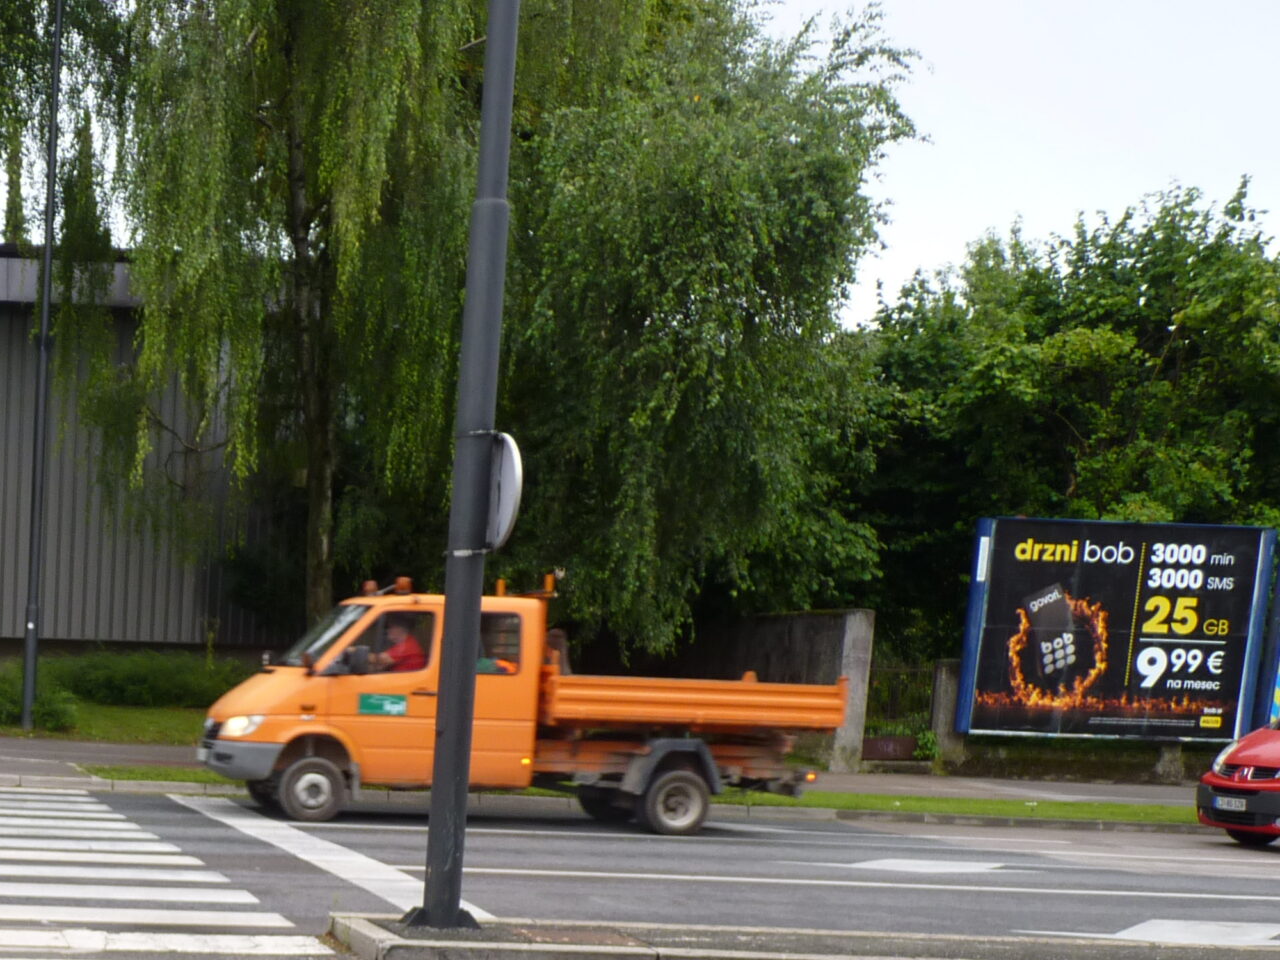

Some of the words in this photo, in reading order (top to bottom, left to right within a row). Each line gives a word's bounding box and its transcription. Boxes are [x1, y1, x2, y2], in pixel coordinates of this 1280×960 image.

[1014, 538, 1079, 563] drzni
[1083, 540, 1135, 565] bob
[1150, 542, 1206, 565] 3000
[1210, 552, 1235, 566] min
[1147, 568, 1203, 589] 3000
[1207, 576, 1234, 591] SMS
[1142, 595, 1199, 635] 25
[1203, 619, 1229, 636] GB
[1041, 632, 1074, 653] bob
[1167, 679, 1181, 689] na
[1183, 679, 1220, 690] mesec
